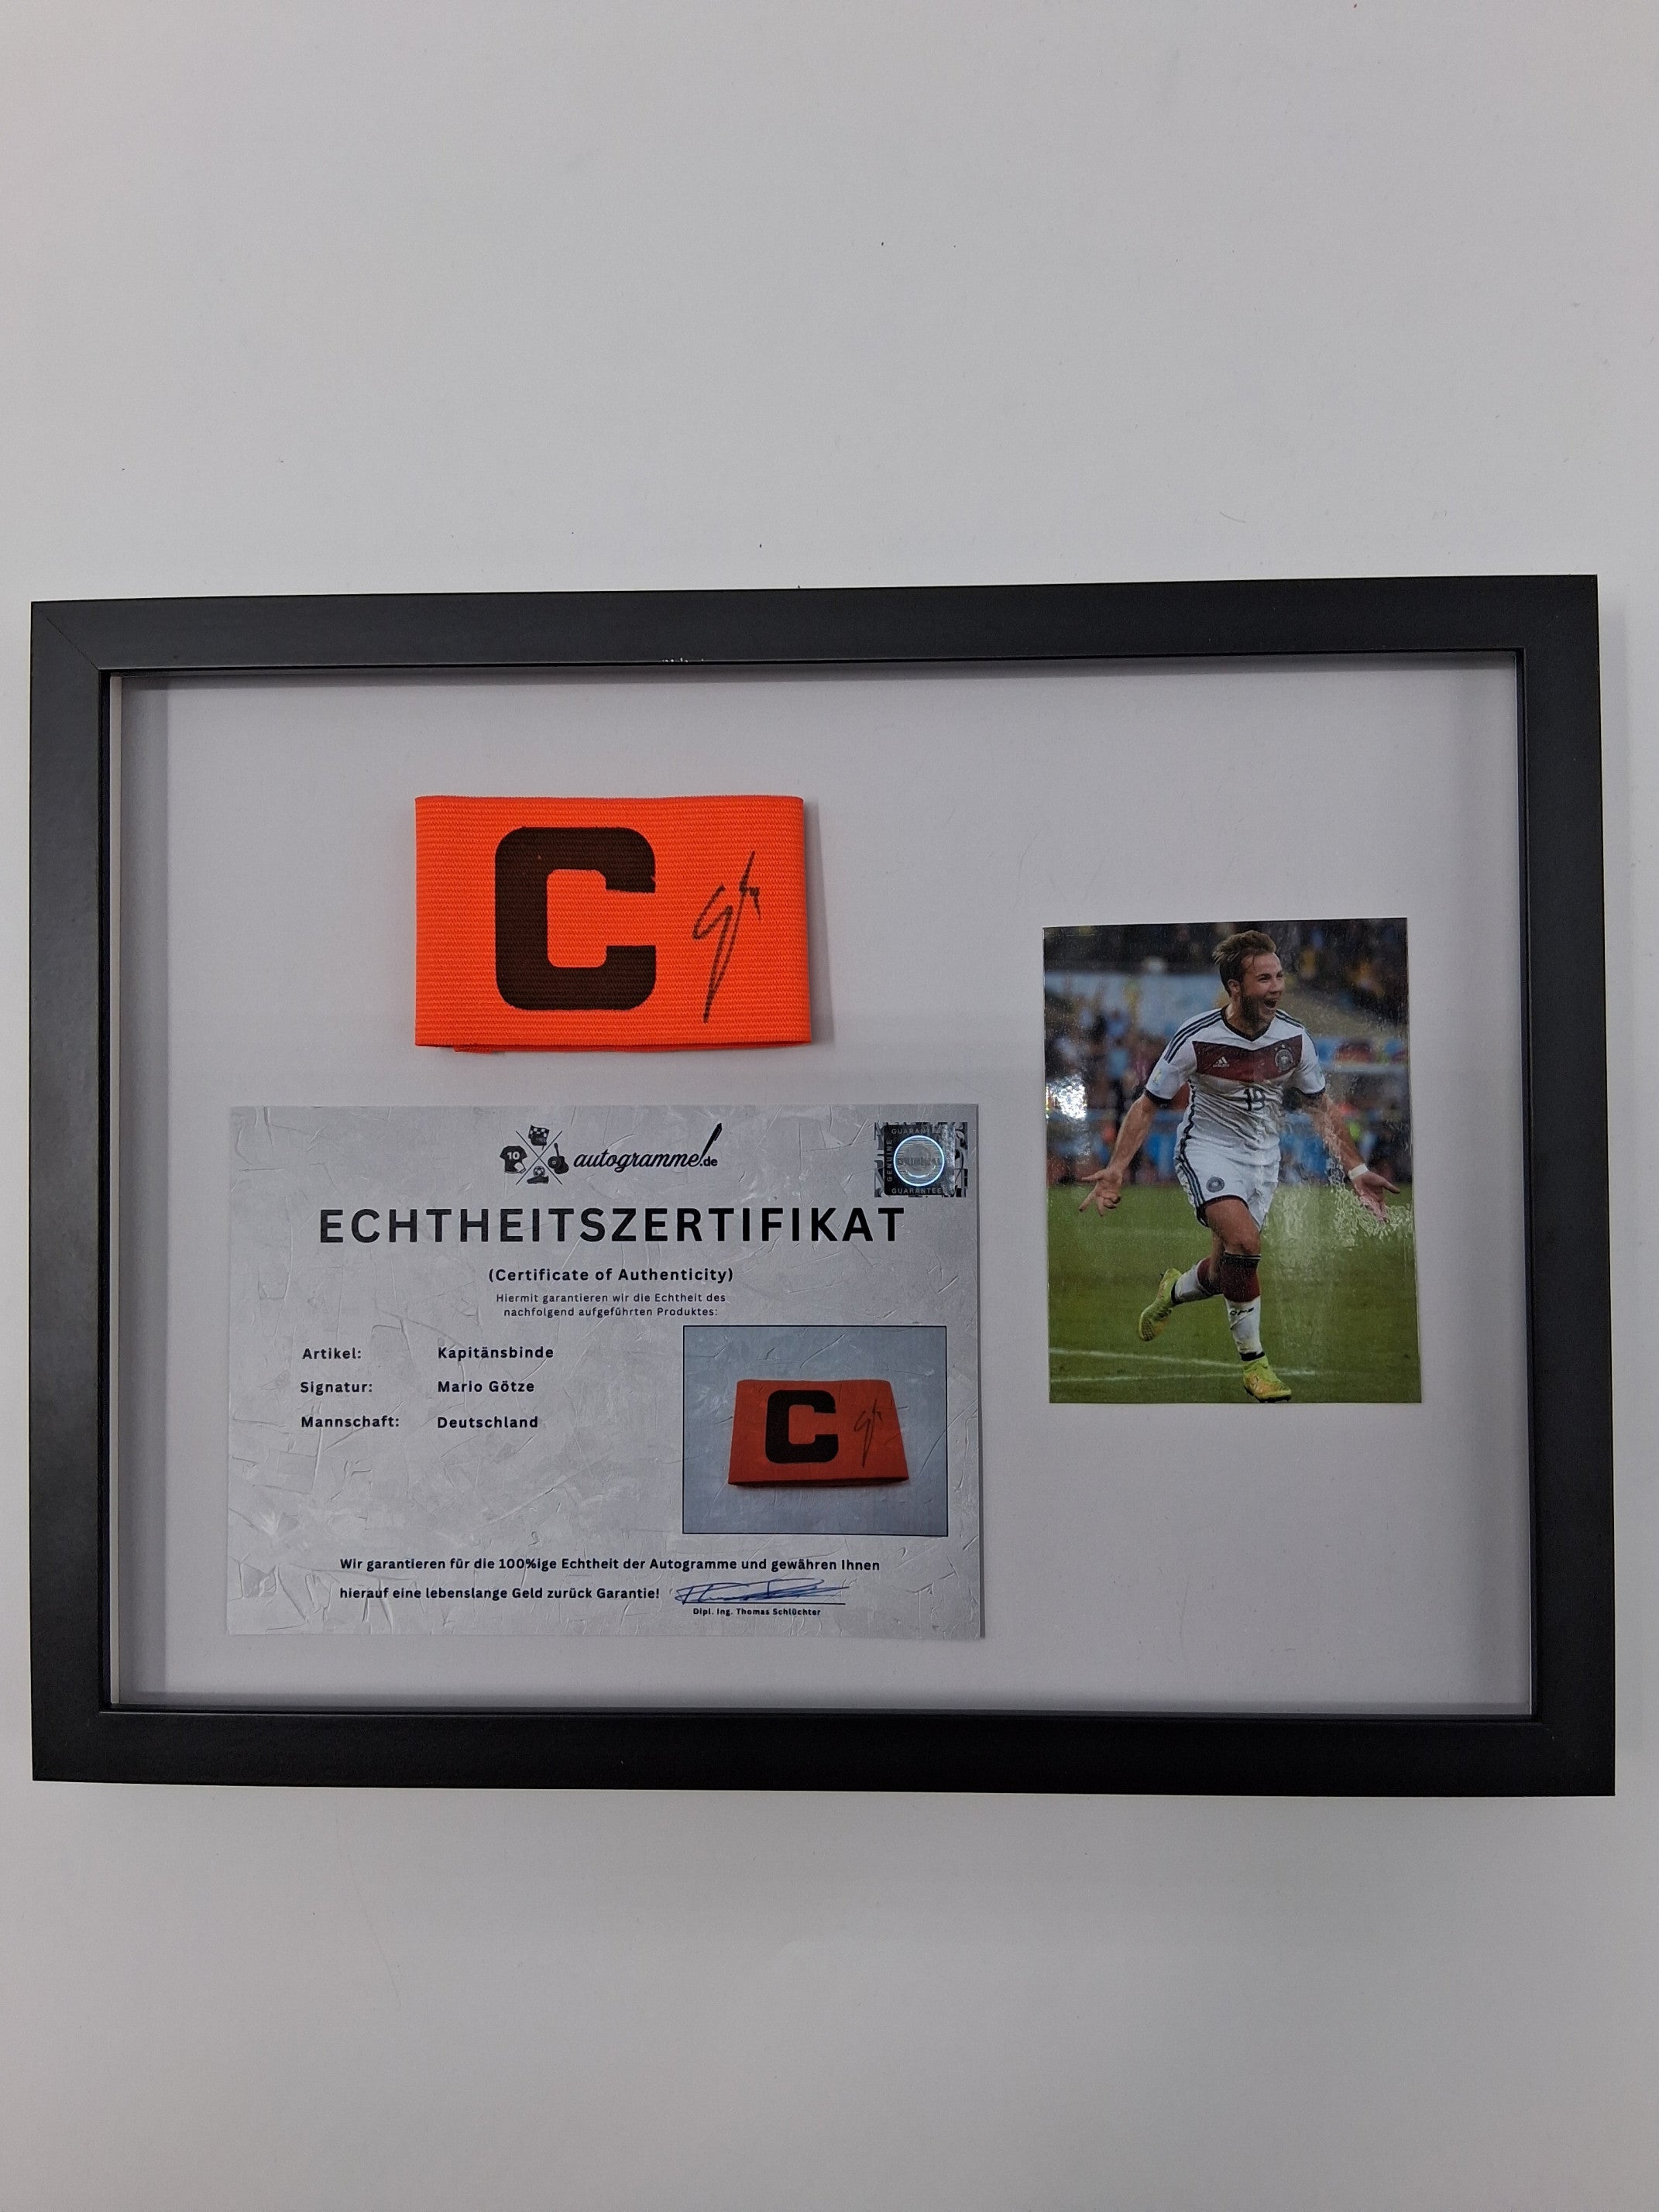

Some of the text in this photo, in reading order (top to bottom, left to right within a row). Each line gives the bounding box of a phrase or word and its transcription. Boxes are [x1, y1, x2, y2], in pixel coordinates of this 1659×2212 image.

[495, 826, 657, 1012] C
[1243, 1087, 1266, 1111] 19
[507, 1151, 520, 1160] 10
[573, 1148, 719, 1173] autogramme.de
[321, 1207, 904, 1242] ECHTHEITSZERTIFIKAT
[489, 1267, 733, 1283] (Certificate of Authenticity)
[496, 1293, 726, 1305] Hiermit garantieren wir die Echtheit des
[503, 1307, 718, 1319] nachfolgend aufgeführten Produktes:
[301, 1346, 554, 1362] Artikel: Kapitänsbinde
[300, 1381, 534, 1396] Signatur: Mario Götze
[301, 1416, 538, 1429] Mannschaft: Deutschland
[766, 1389, 839, 1464] C
[339, 1558, 880, 1573] Wir garantieren für die 100%ige Echtheit der Autogramme und gewähren Ihnen
[340, 1588, 660, 1602] hierauf eine lebenslange Geld zurück Garantie!
[692, 1608, 714, 1616] Dipl.
[716, 1608, 733, 1616] Ing.
